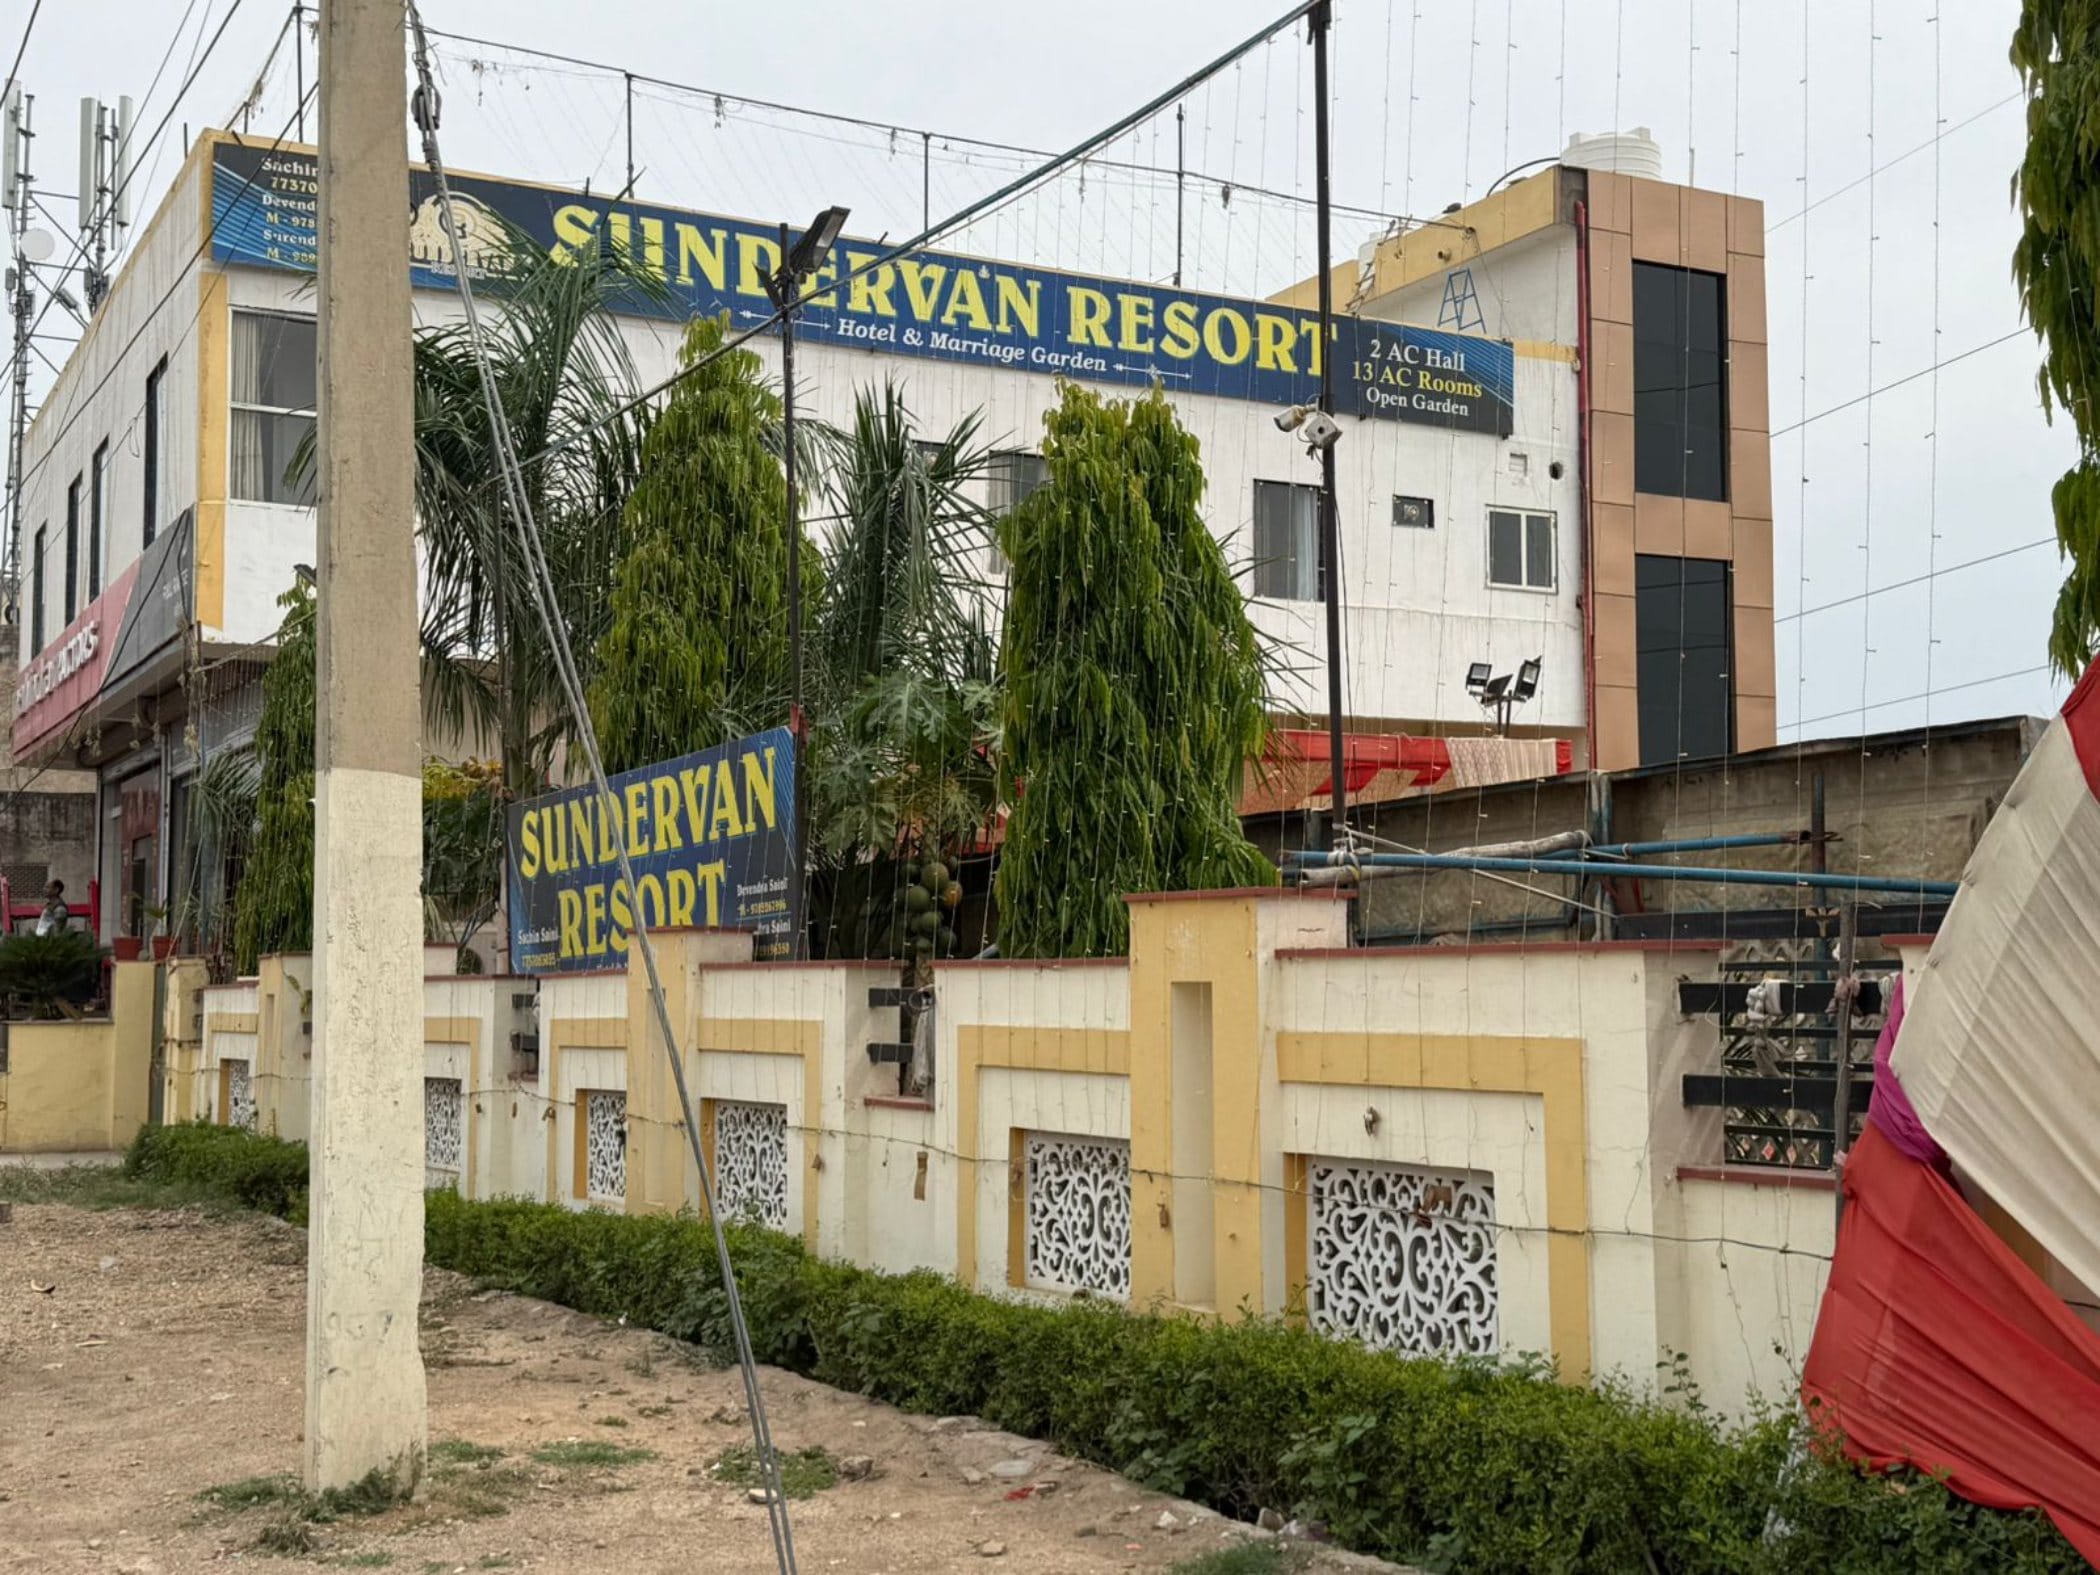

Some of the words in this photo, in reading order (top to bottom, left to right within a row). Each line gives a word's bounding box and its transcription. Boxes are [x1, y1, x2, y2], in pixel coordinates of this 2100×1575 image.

[271, 176, 317, 193] 77370
[262, 194, 316, 211] Devend
[263, 229, 316, 246] Surend
[291, 217, 316, 229] 978
[548, 204, 1042, 338] SUNDERVAN
[1066, 285, 1338, 377] RESORT
[838, 318, 897, 343] Hotel
[903, 327, 924, 347] &
[930, 331, 1026, 363] Marriage
[1031, 346, 1107, 372] Garden
[1369, 339, 1382, 359] 2
[1386, 342, 1420, 365] AC
[1424, 348, 1466, 372] Hall
[1352, 360, 1374, 382] 13
[1379, 365, 1412, 387] AC
[1417, 370, 1483, 398] Rooms
[1366, 387, 1408, 408] Open
[1412, 393, 1469, 416] Garden
[520, 747, 776, 879] SUNDERVAN
[558, 858, 726, 959] RESORT
